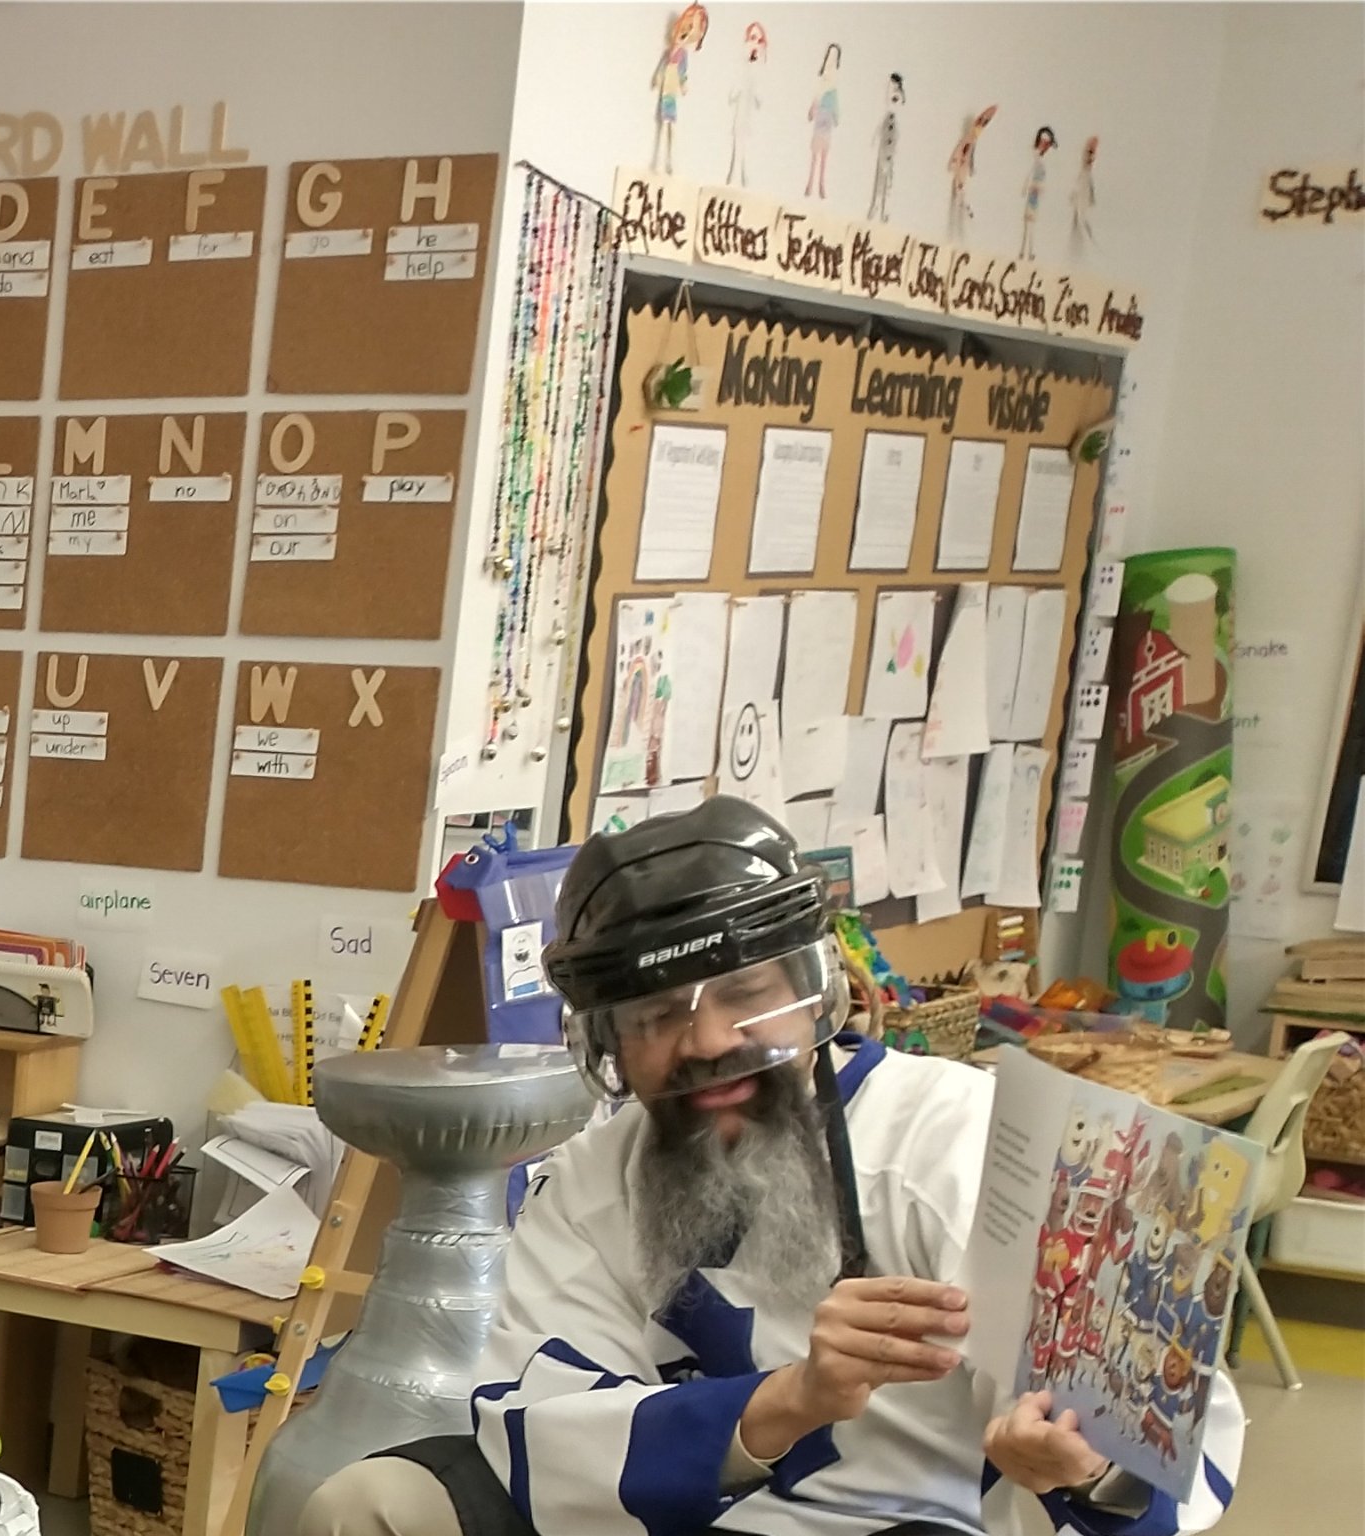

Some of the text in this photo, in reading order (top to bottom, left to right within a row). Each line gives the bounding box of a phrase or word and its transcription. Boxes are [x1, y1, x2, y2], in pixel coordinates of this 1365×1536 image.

[81, 101, 249, 172] WALL
[185, 170, 225, 232] F
[297, 162, 342, 228] G
[400, 157, 452, 223] H
[78, 178, 118, 240] E
[417, 227, 437, 247] he
[88, 247, 114, 265] eat
[405, 254, 445, 280] help
[716, 331, 1051, 433] Making Learning visible
[63, 416, 107, 475] M
[159, 415, 205, 475] N
[269, 413, 316, 474] O
[372, 412, 421, 474] P
[174, 487, 196, 498] no
[388, 479, 427, 501] play
[71, 510, 96, 527] me
[273, 513, 297, 528] on
[69, 536, 92, 553] my
[269, 541, 300, 556] our
[46, 654, 89, 708] U
[143, 658, 179, 711] V
[249, 665, 298, 724] W
[348, 668, 386, 727] X
[52, 714, 70, 731] up
[45, 736, 87, 756] under
[257, 755, 289, 774] with
[80, 892, 151, 917] airplane
[329, 926, 373, 956] Sad
[638, 932, 724, 968] BAUER
[148, 960, 211, 991] Seven
